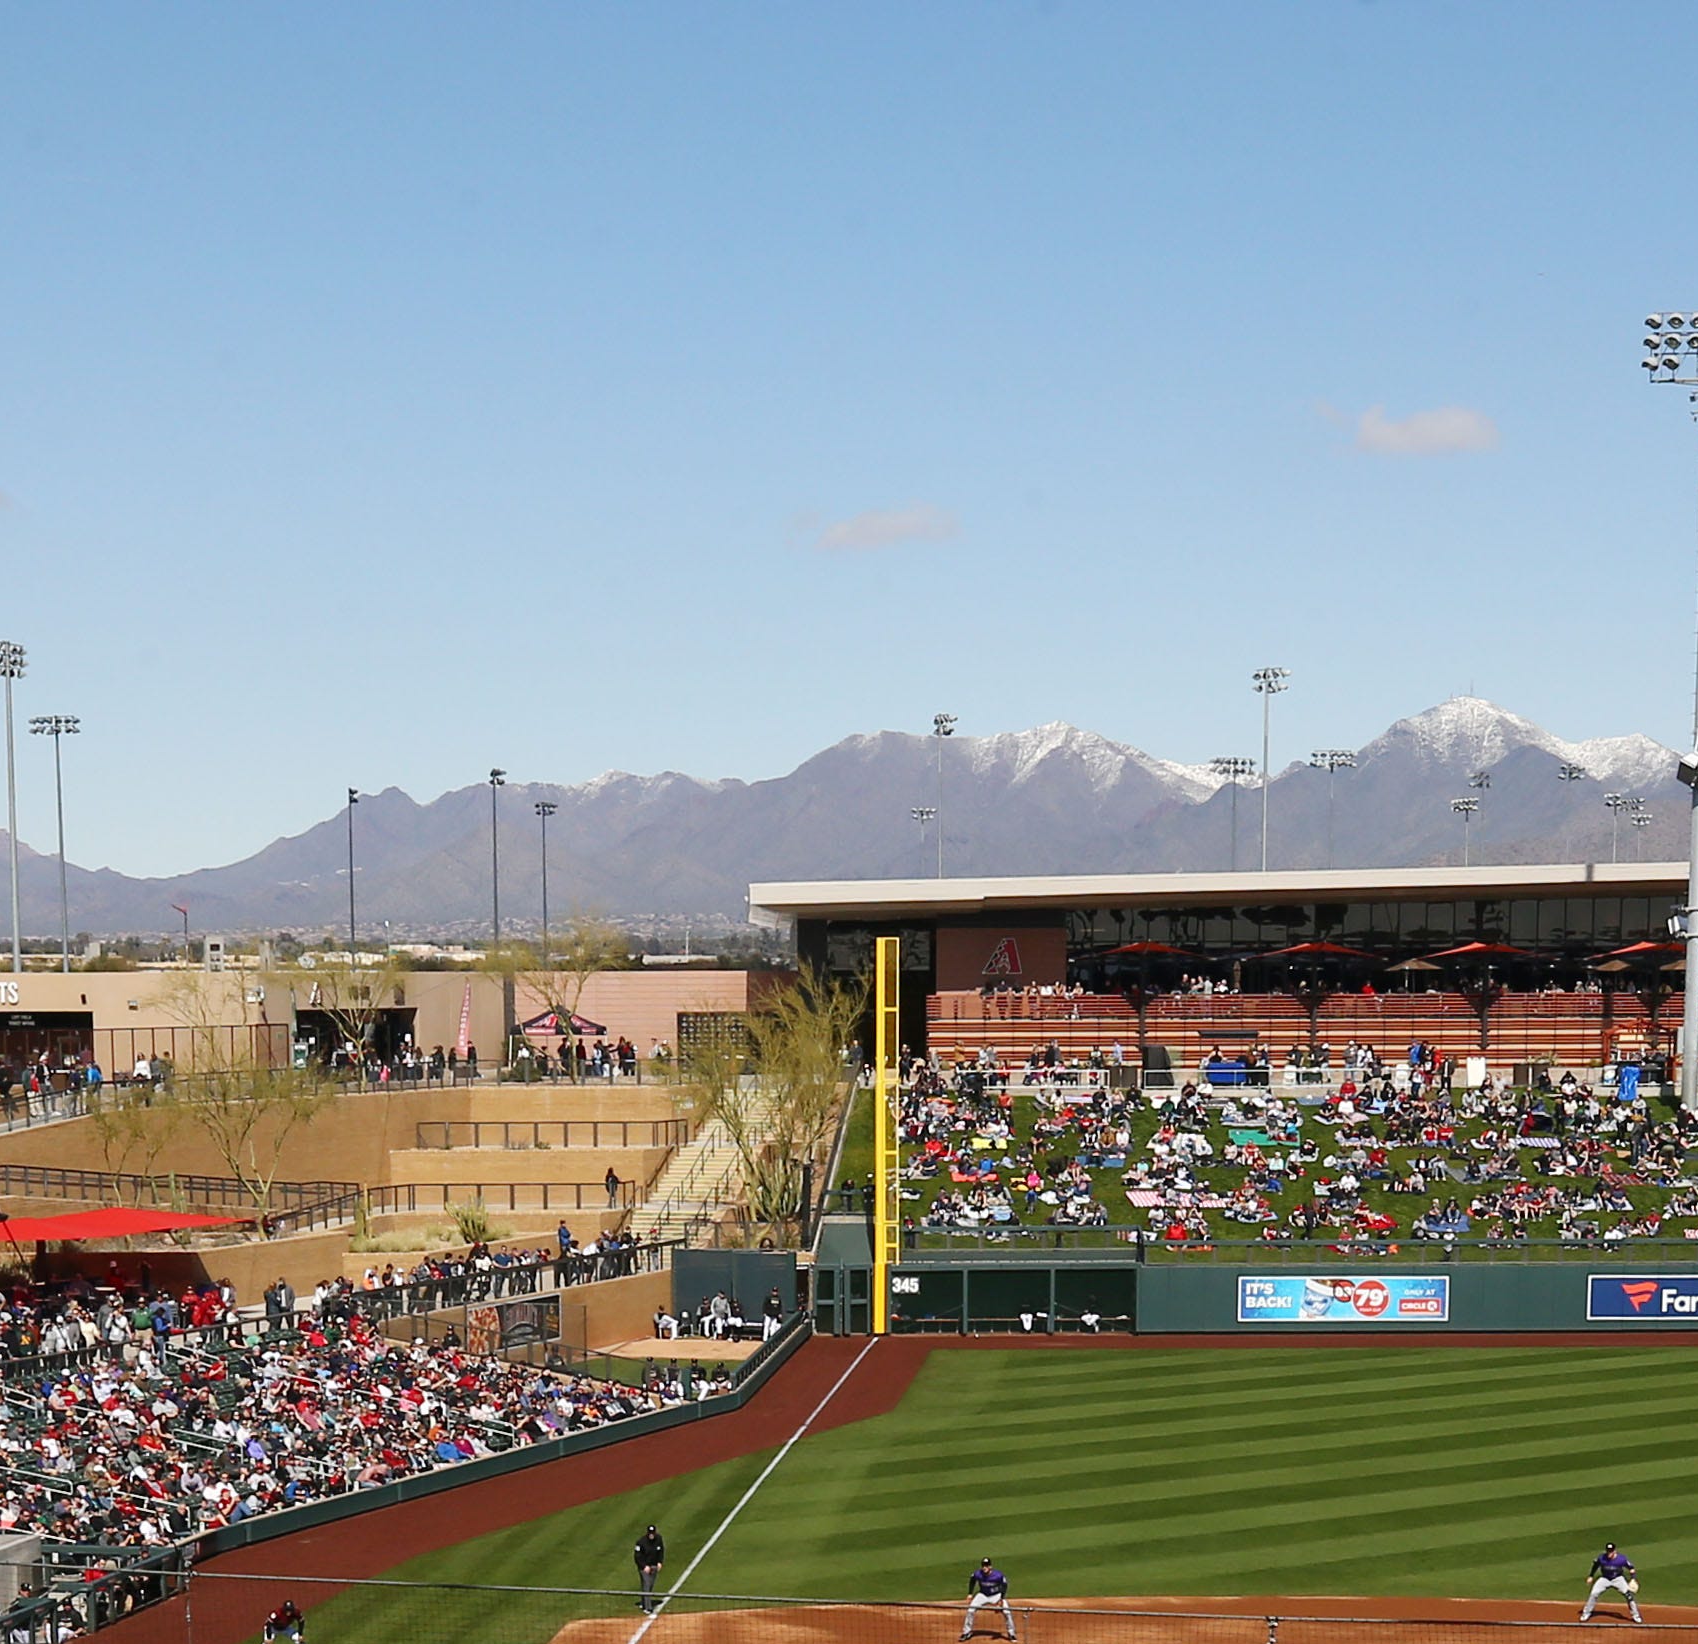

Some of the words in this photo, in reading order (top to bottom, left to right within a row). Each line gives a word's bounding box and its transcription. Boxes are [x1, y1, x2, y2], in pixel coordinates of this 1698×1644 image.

[892, 1277, 919, 1294] 345
[1245, 1283, 1274, 1295] IT'S
[1245, 1296, 1292, 1309] BACK!
